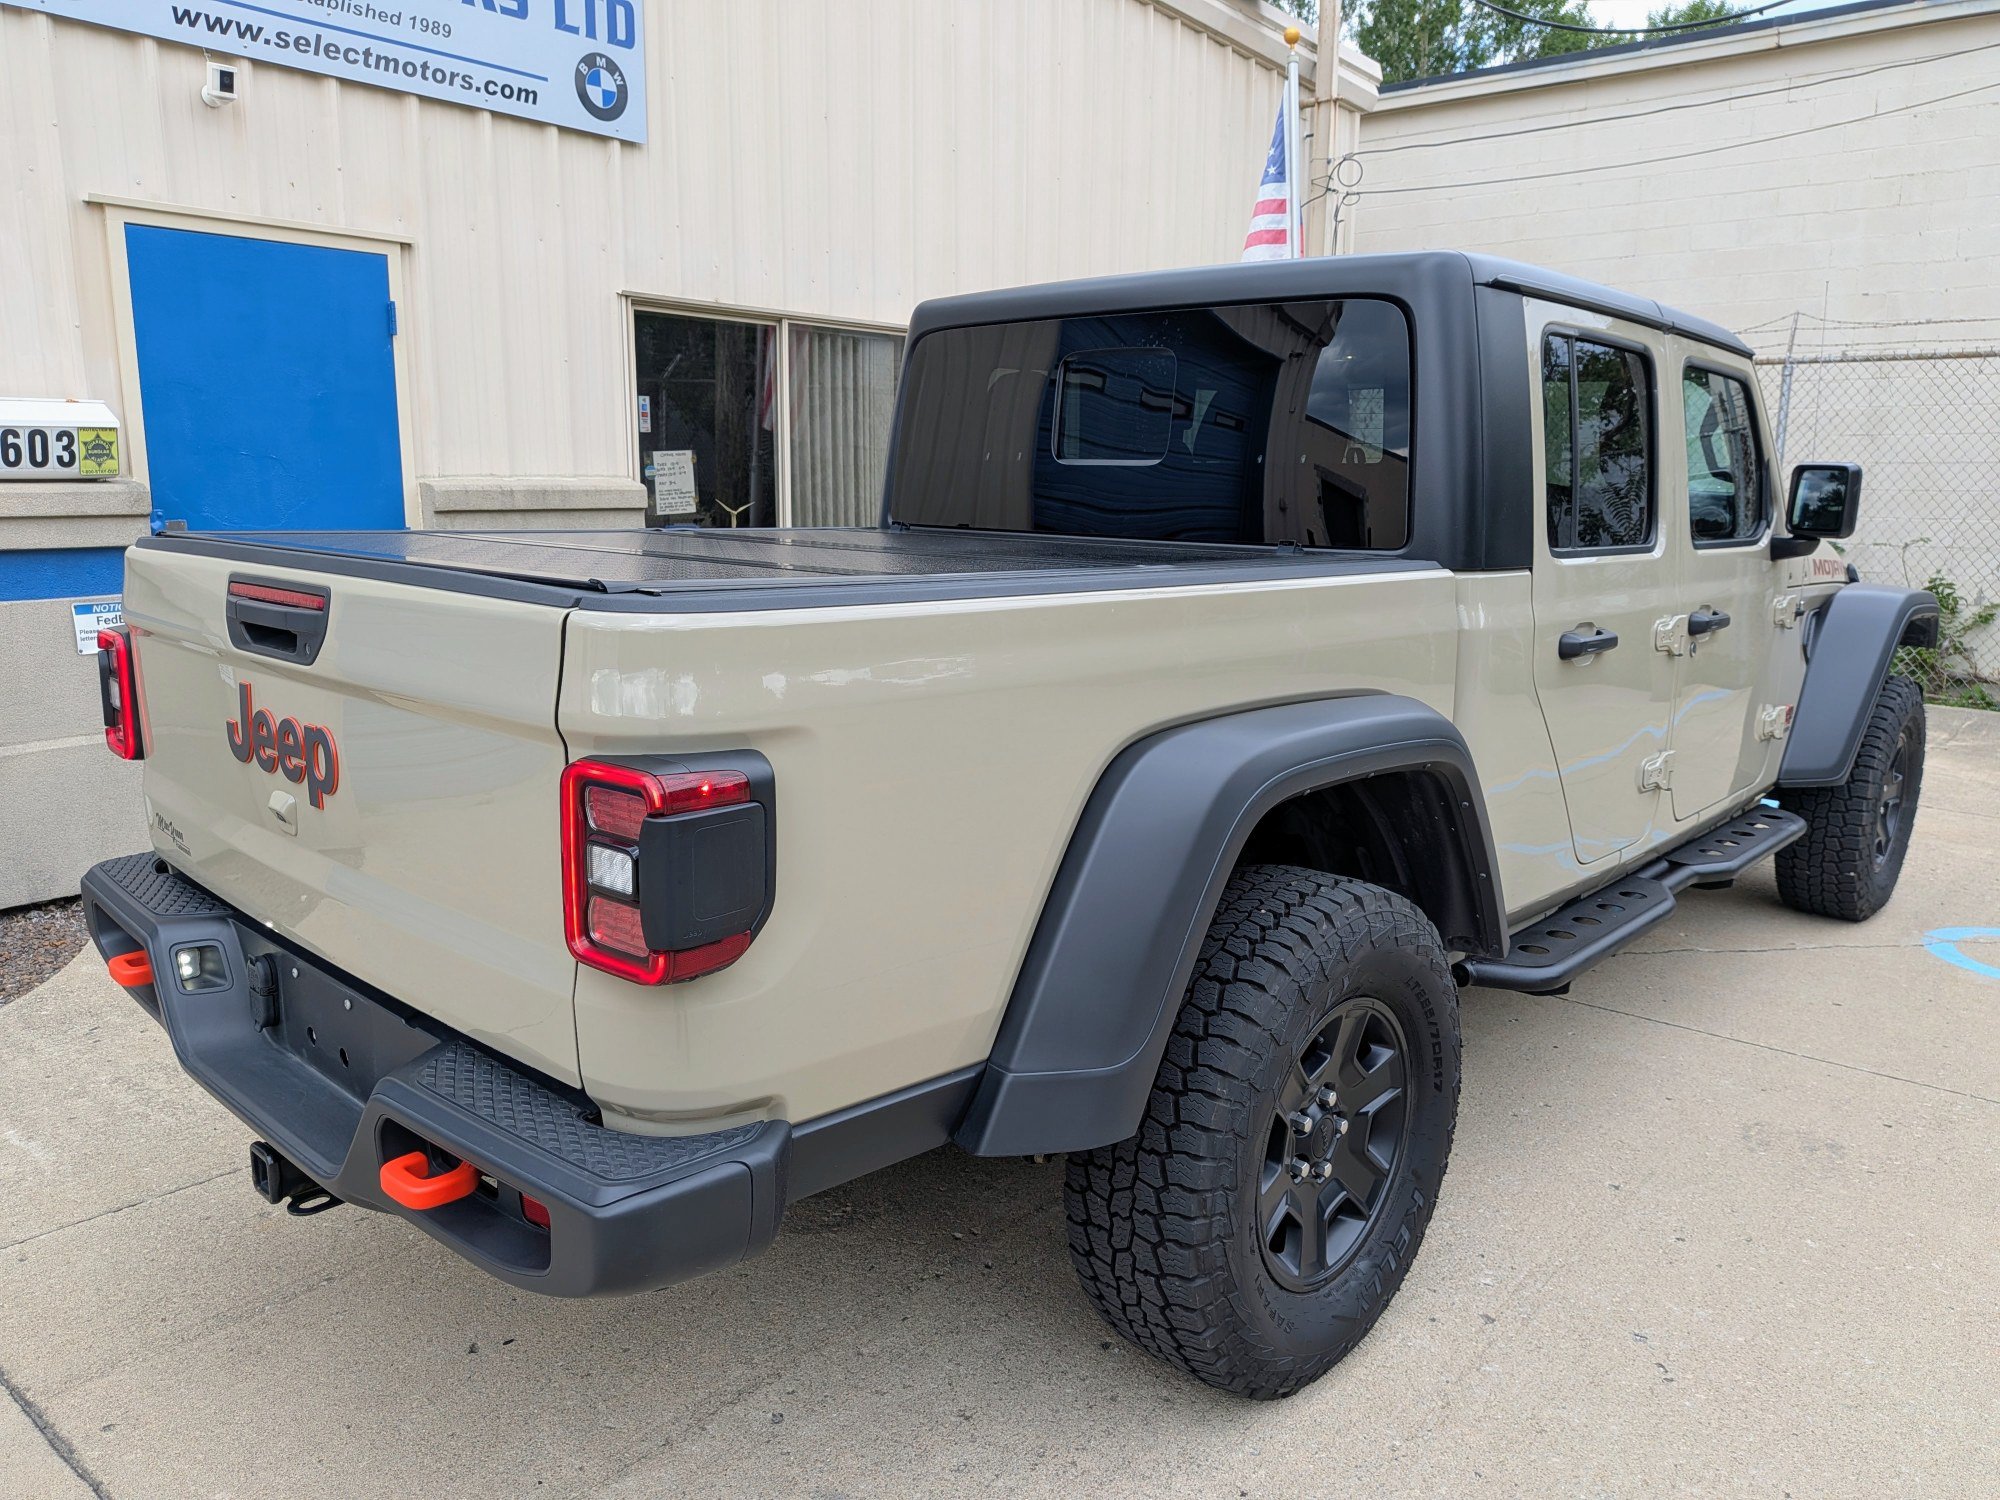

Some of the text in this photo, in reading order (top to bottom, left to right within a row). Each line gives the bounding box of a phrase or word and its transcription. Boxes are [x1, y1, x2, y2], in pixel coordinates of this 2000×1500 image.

[298, 0, 452, 39] ablished 1989
[171, 5, 539, 106] www.selectmotors.com
[578, 55, 624, 86] BMW
[0, 428, 77, 469] 603
[1812, 558, 1845, 579] MOJAV
[92, 603, 122, 613] NOTI
[96, 614, 125, 626] FedE
[226, 680, 340, 811] Jeep
